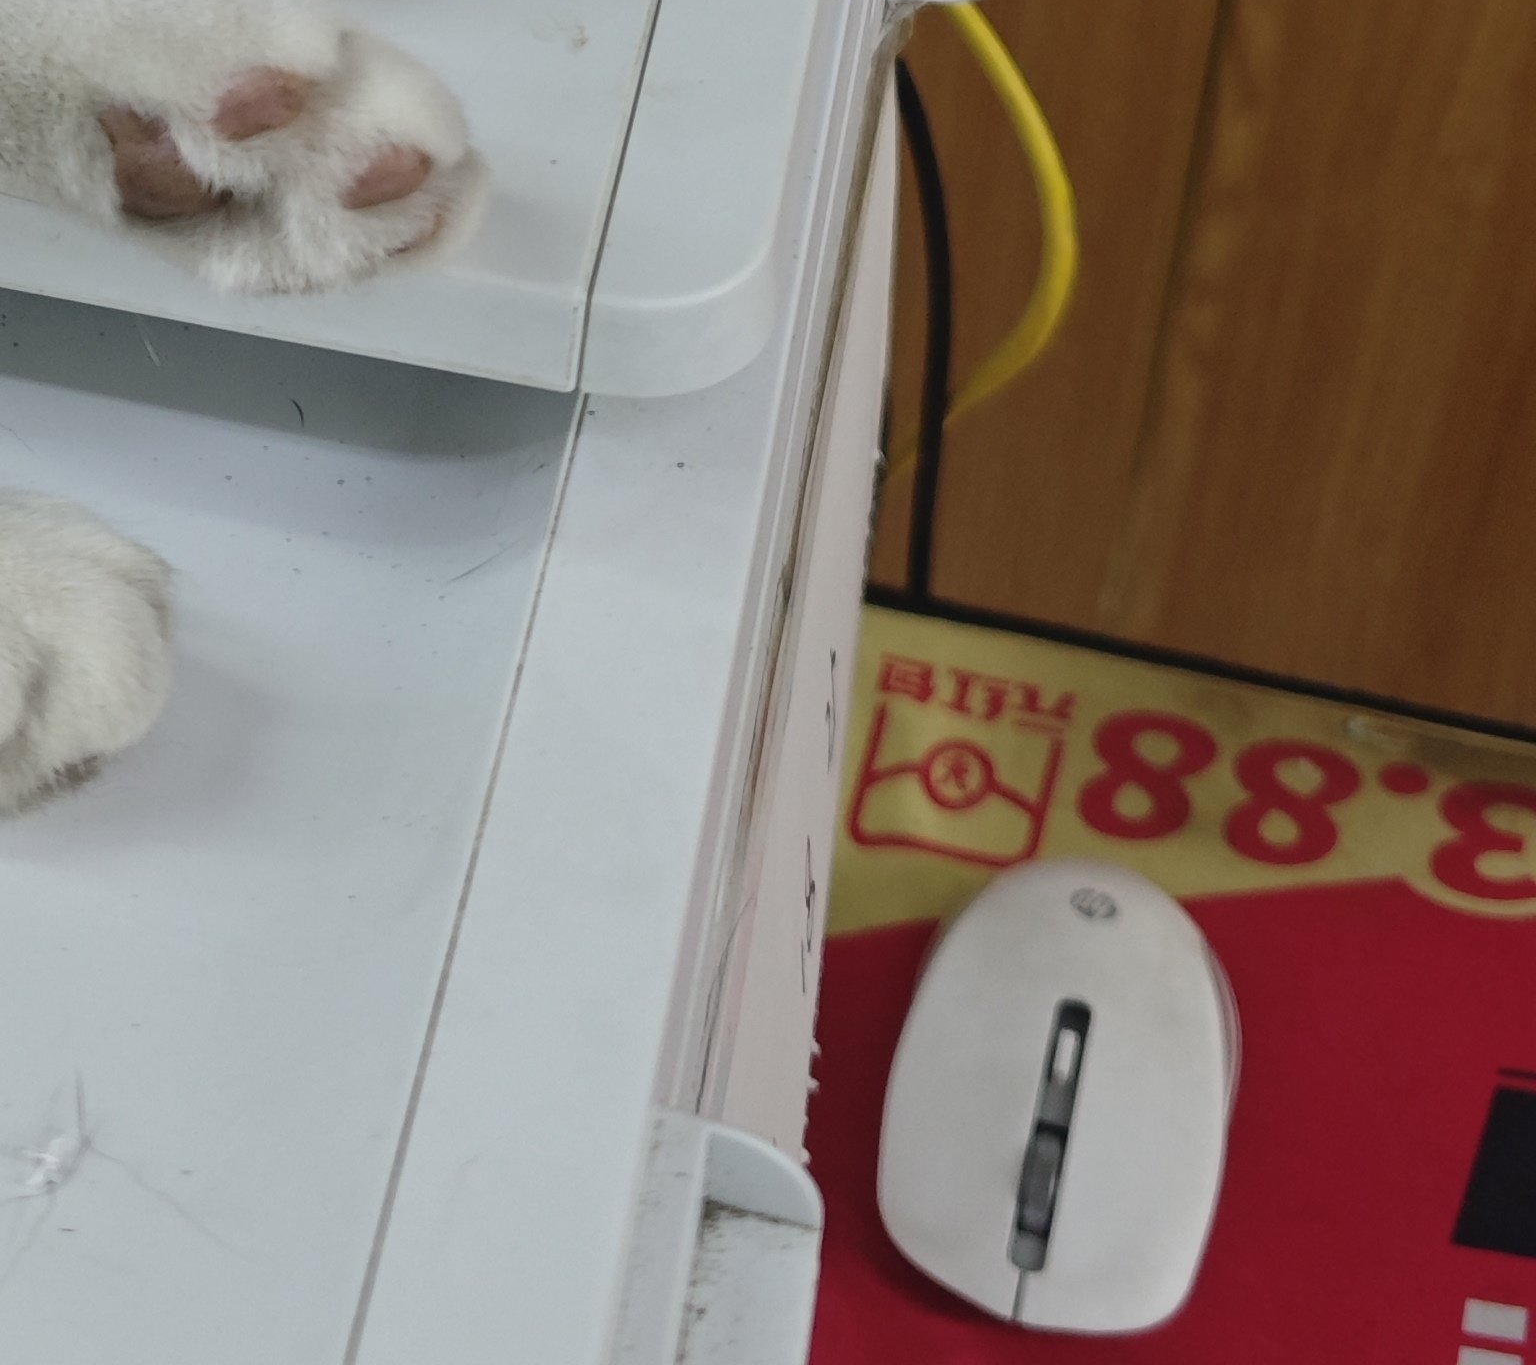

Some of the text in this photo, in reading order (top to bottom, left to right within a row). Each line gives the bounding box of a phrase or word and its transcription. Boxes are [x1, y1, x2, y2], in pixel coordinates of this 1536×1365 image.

[876, 652, 1075, 730] 元红包
[1075, 709, 1536, 901] 3.88
